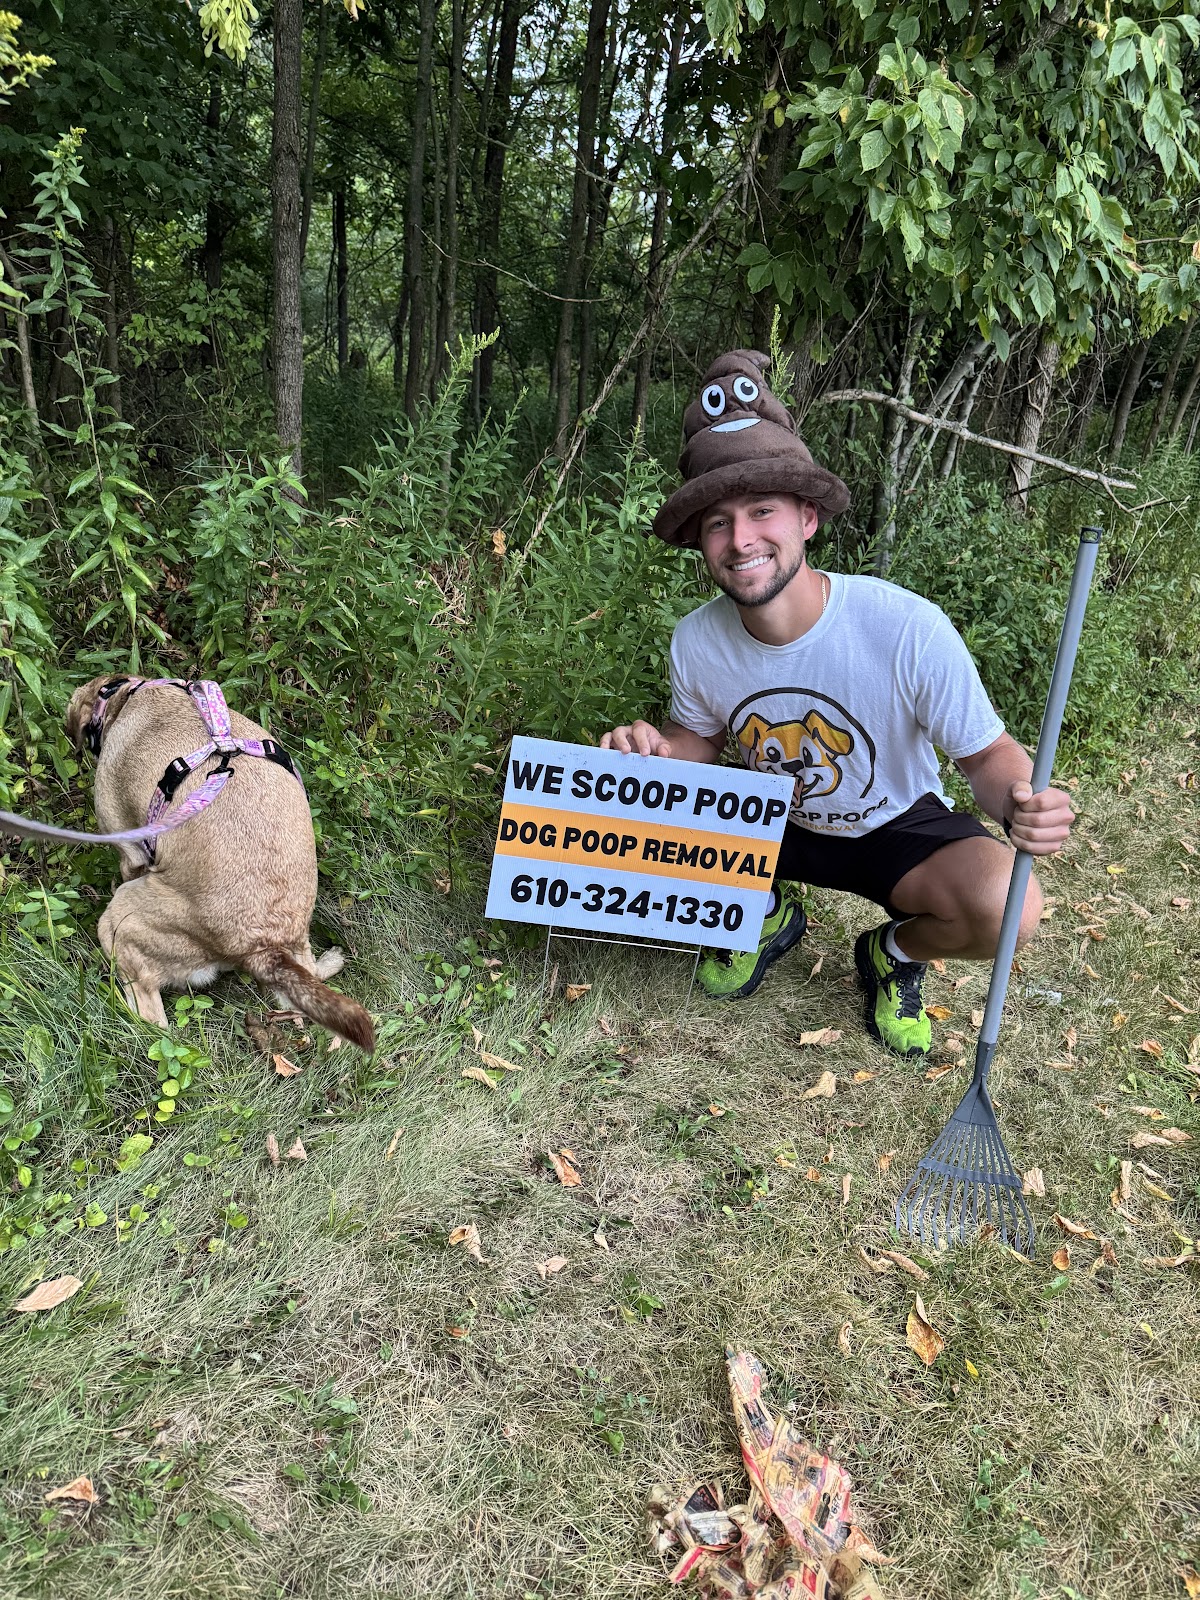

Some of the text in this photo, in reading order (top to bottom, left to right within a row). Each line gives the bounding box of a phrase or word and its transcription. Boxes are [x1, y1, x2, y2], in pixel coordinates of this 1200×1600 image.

[512, 759, 787, 827] WE SCOOP POOP
[499, 818, 773, 879] DOG POOP REMOVAL
[510, 874, 744, 932] 610-324-1330
